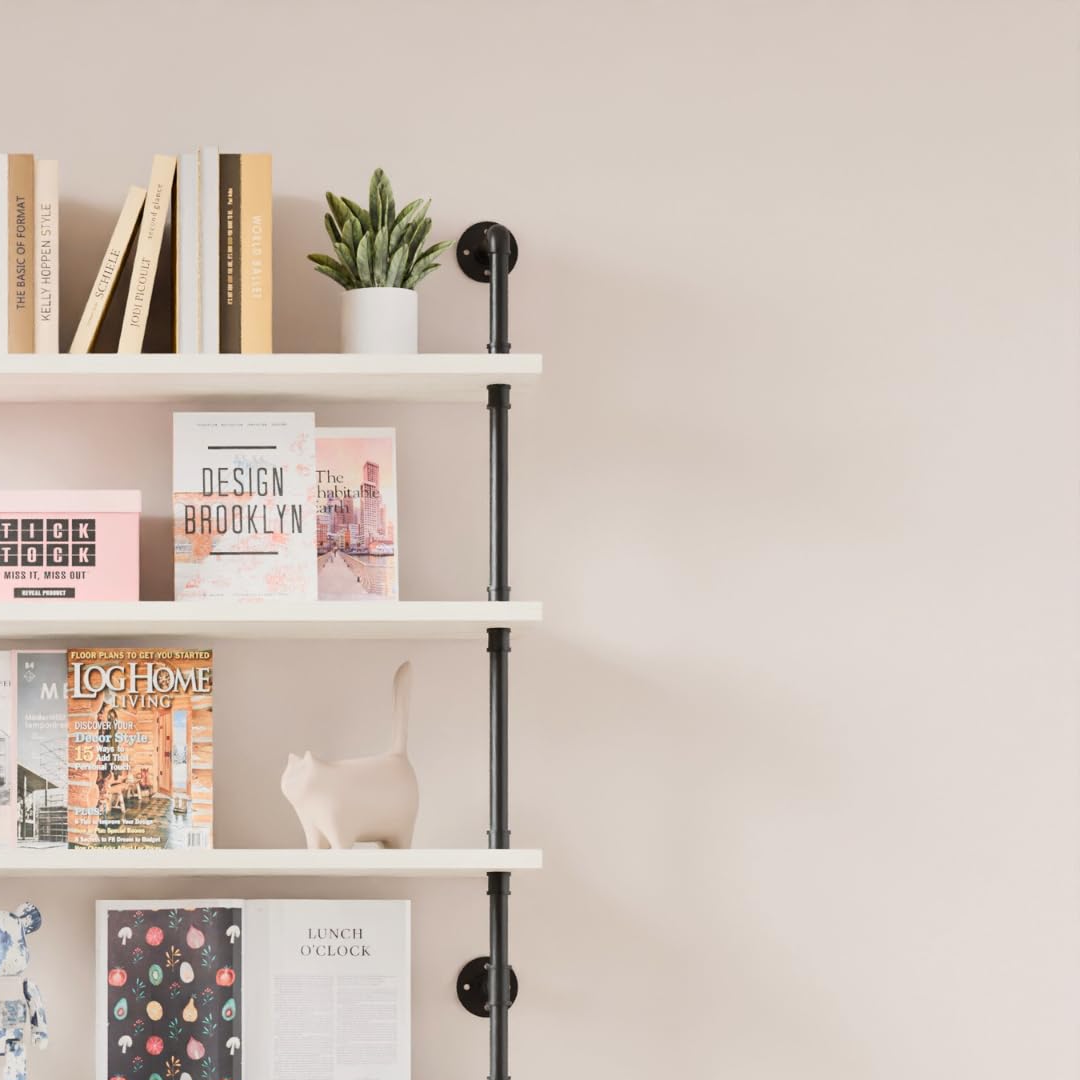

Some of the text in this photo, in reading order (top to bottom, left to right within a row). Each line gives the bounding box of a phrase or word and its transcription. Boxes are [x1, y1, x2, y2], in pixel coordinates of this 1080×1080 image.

[147, 184, 163, 240] second glance
[16, 196, 26, 310] THE BASIC OF FORMAT
[40, 204, 52, 321] KELLY HOPPEN STYLE
[95, 249, 121, 299] SCHIELE
[130, 257, 151, 328] JODI PICOULT
[202, 467, 284, 497] DESIGN
[315, 470, 344, 484] The
[317, 485, 380, 498] habitable
[184, 504, 303, 534] BROOKLYN
[1, 523, 89, 539] TICK
[1, 547, 89, 563] TOCK
[4, 571, 87, 581] MISS IT, MISS OUT
[71, 651, 210, 659] FLOOR PLANS TO GET YOU STARTED
[113, 695, 172, 708] LIVING
[75, 721, 112, 730] DISCOVER
[114, 732, 148, 746] Style
[75, 746, 94, 761] 15
[307, 928, 363, 940] LUNCH
[300, 944, 371, 957] O'CLOCK
